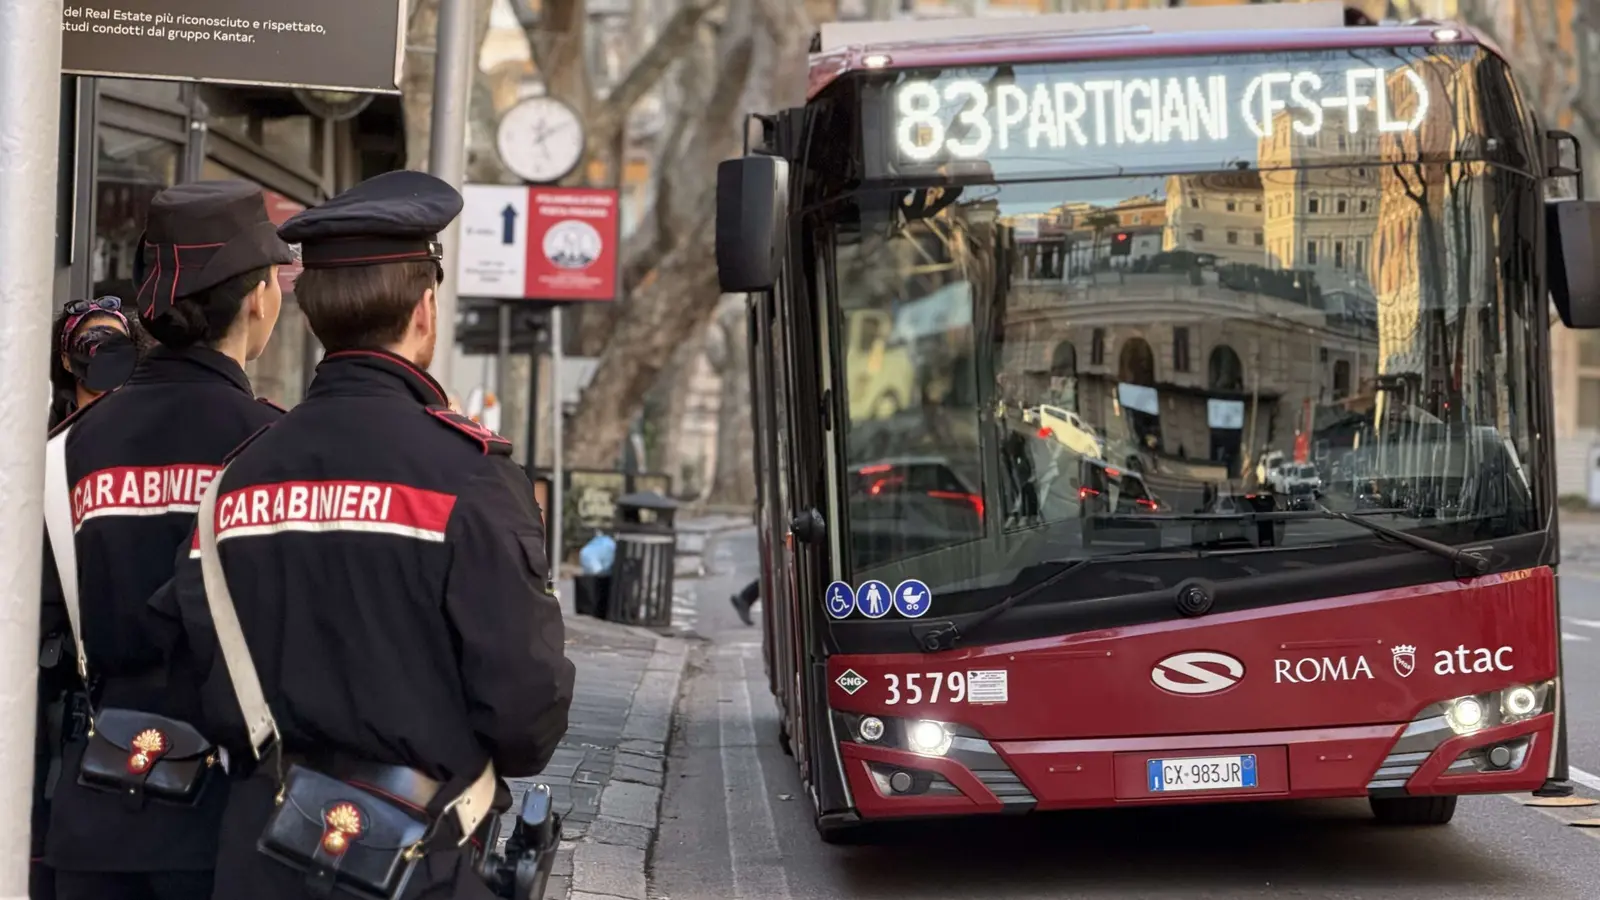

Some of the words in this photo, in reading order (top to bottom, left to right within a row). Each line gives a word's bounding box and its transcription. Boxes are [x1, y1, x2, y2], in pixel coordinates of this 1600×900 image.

[63, 6, 82, 17] del
[85, 8, 110, 19] Real
[113, 10, 152, 22] Estate
[155, 13, 174, 25] più
[176, 14, 250, 28] riconosciuto
[252, 20, 260, 29] e
[262, 19, 326, 35] rispettato,
[92, 24, 144, 36] condotti
[147, 26, 165, 37] dal
[167, 29, 211, 42] gruppo
[213, 30, 256, 43] Kantar.
[898, 79, 992, 160] 83
[996, 75, 1228, 150] PARTIGIANI
[1241, 67, 1429, 137] (FS-FL)
[219, 485, 392, 529] CARABINIERI
[1274, 655, 1375, 683] ROMA
[1434, 644, 1514, 676] atac
[840, 677, 861, 686] CNG
[883, 671, 966, 705] 3579
